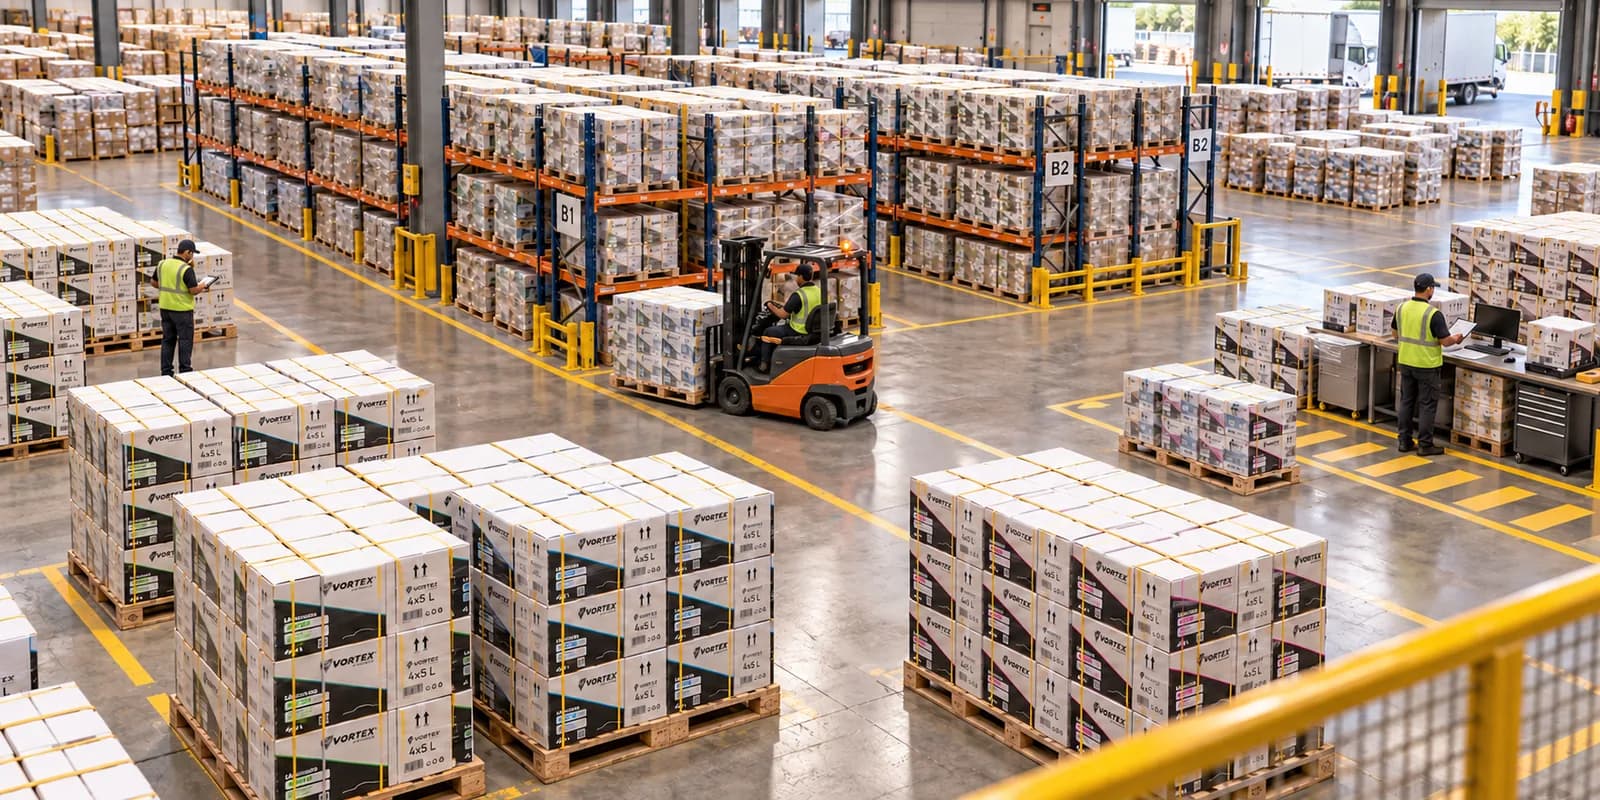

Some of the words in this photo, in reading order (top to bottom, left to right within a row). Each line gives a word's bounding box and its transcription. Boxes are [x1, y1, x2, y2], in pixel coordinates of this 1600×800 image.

[1193, 137, 1208, 152] B2
[1051, 160, 1069, 176] B2
[562, 204, 574, 225] B1
[363, 400, 387, 408] VORTEX
[265, 415, 292, 424] VORTEX
[155, 433, 183, 443] VORTEX
[931, 496, 952, 508] VORTEX
[700, 511, 728, 522] VORTEX
[586, 534, 617, 547] VORTEX
[1010, 528, 1033, 543] VORTEX
[931, 558, 952, 571] VORTEX
[1299, 552, 1321, 564] VORTEX
[1102, 566, 1127, 582] VORTEX
[333, 576, 375, 592] VORTEX
[700, 576, 728, 587] VORTEX
[1206, 576, 1233, 589] VORTEX
[408, 593, 426, 605] 4x5
[428, 592, 435, 602] L
[1008, 593, 1031, 609] VORTEX
[586, 602, 617, 616] VORTEX
[931, 621, 951, 634] VORTEX
[700, 642, 728, 655] VORTEX
[1100, 634, 1126, 652] VORTEX
[333, 651, 375, 668] VORTEX
[1204, 648, 1231, 663] VORTEX
[408, 668, 427, 680] 4x5
[429, 666, 436, 676] L
[1008, 660, 1030, 675] VORTEX
[586, 671, 618, 687] VORTEX
[1099, 706, 1126, 726] VORTEX
[333, 727, 376, 744] VORTEX
[409, 743, 428, 755] 4x5
[430, 741, 436, 751] L
